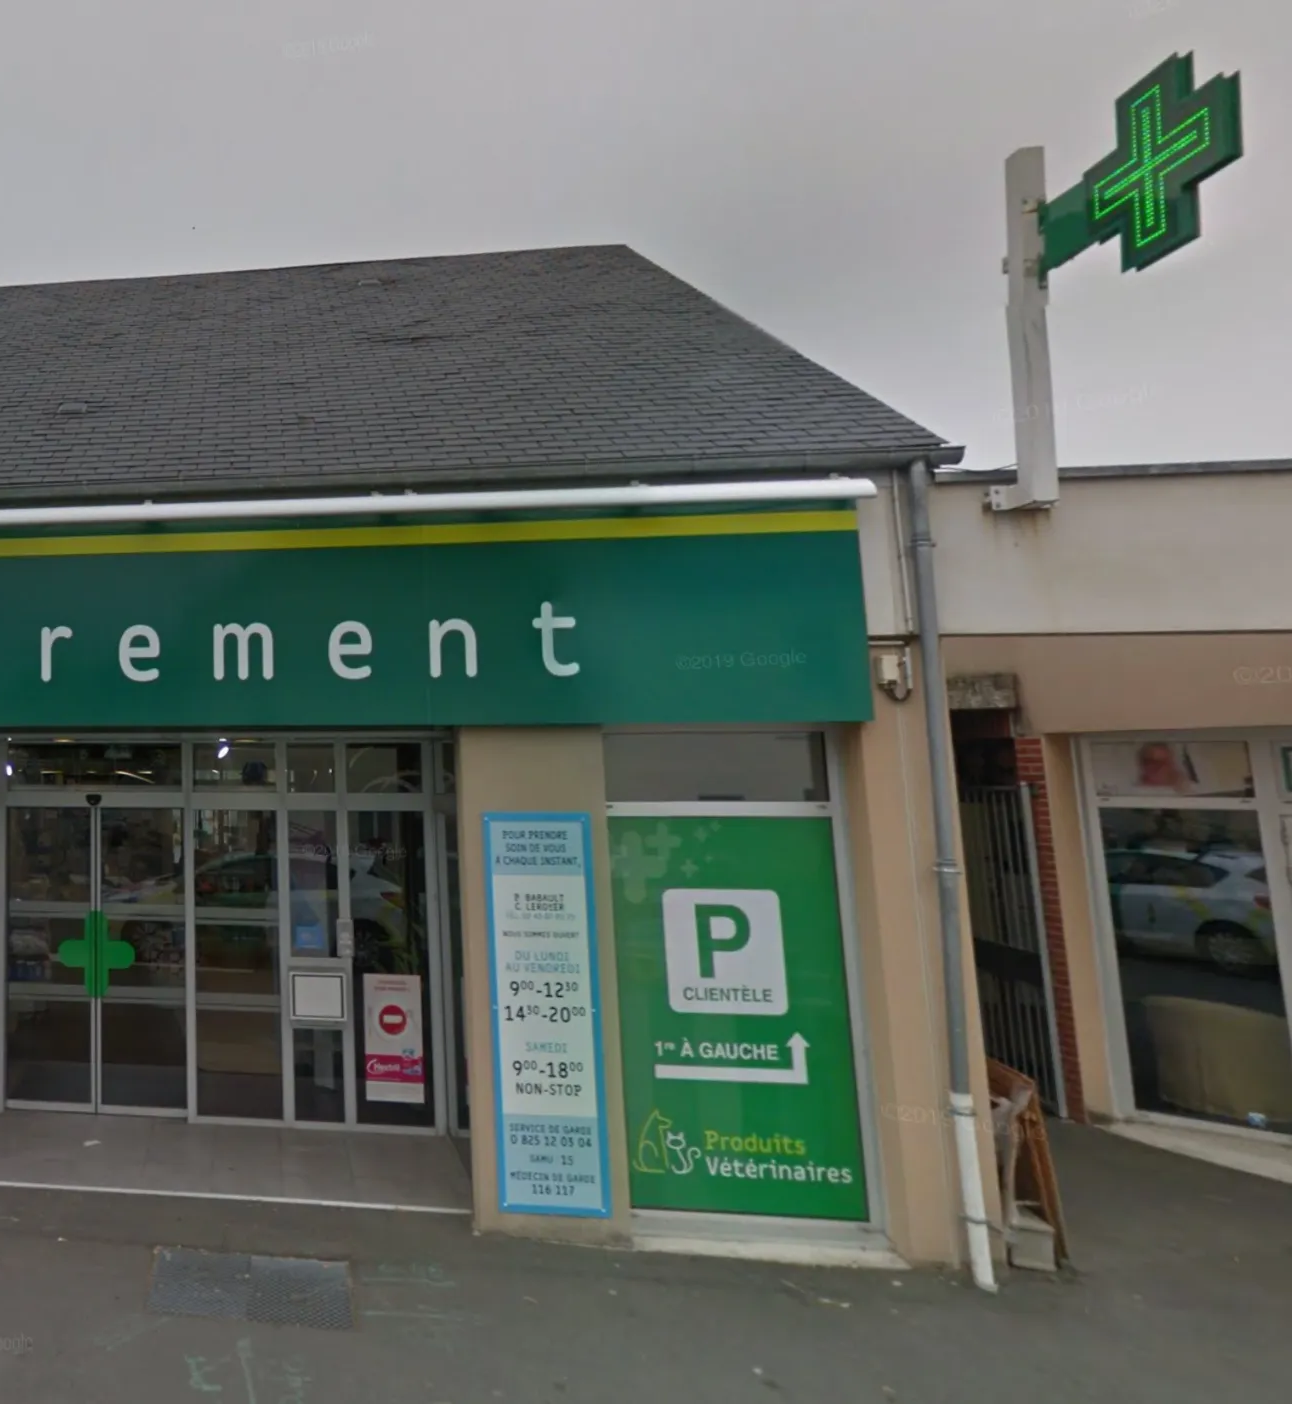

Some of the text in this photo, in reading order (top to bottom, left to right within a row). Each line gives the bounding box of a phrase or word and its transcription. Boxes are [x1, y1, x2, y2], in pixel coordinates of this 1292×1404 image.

[529, 843, 540, 853] DE
[694, 904, 750, 979] P
[515, 950, 569, 962] DU LUNDI
[506, 961, 580, 974] AU VENDREDI
[682, 985, 773, 1003] CLIENTÈLE
[525, 1041, 567, 1054] SAMEDI
[680, 1037, 694, 1058] À
[699, 1042, 780, 1061] GAUCHE
[516, 1083, 582, 1097] NON-STOP
[511, 1134, 518, 1145] 0
[521, 1134, 541, 1146] 825
[544, 1135, 557, 1147] 12
[704, 1130, 806, 1155] Produits
[561, 1154, 574, 1166] 15
[705, 1156, 853, 1184] Vétérinaires
[531, 1183, 575, 1196] 116 117
